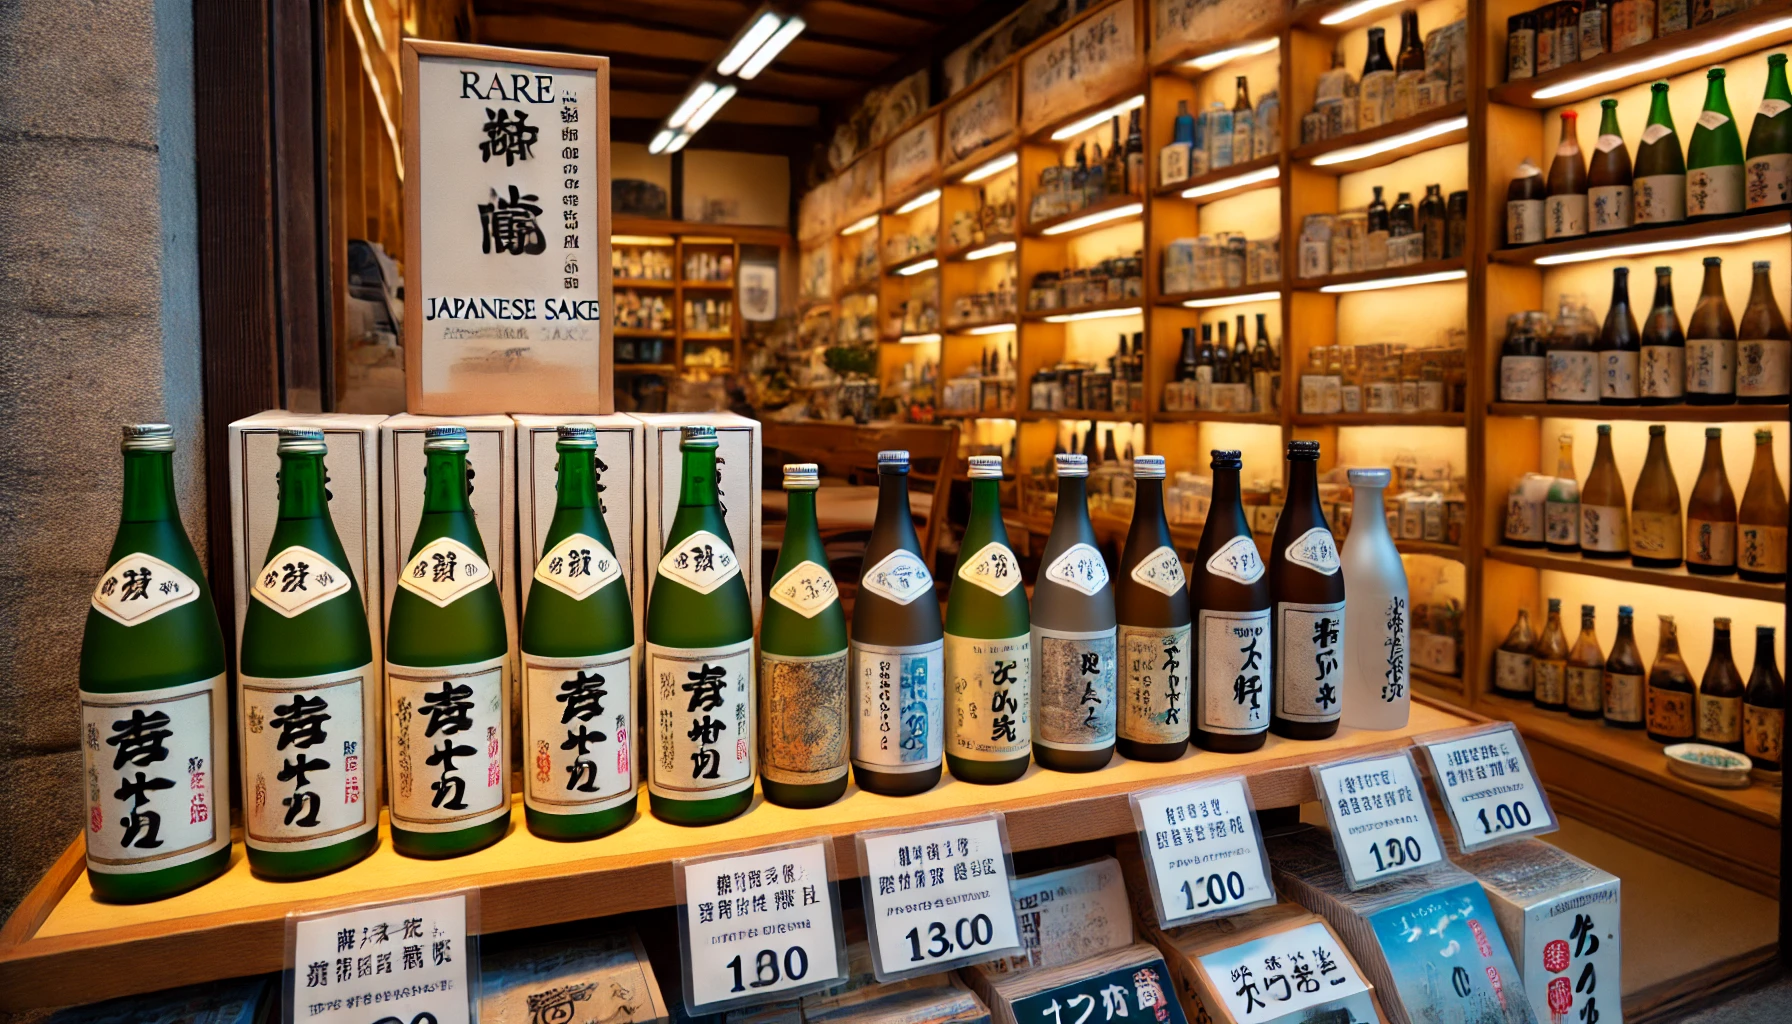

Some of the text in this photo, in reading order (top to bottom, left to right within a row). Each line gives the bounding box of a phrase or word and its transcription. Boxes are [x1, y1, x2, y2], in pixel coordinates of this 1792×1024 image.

[460, 71, 555, 104] RARE
[426, 297, 600, 321] JAPANESE SAKE
